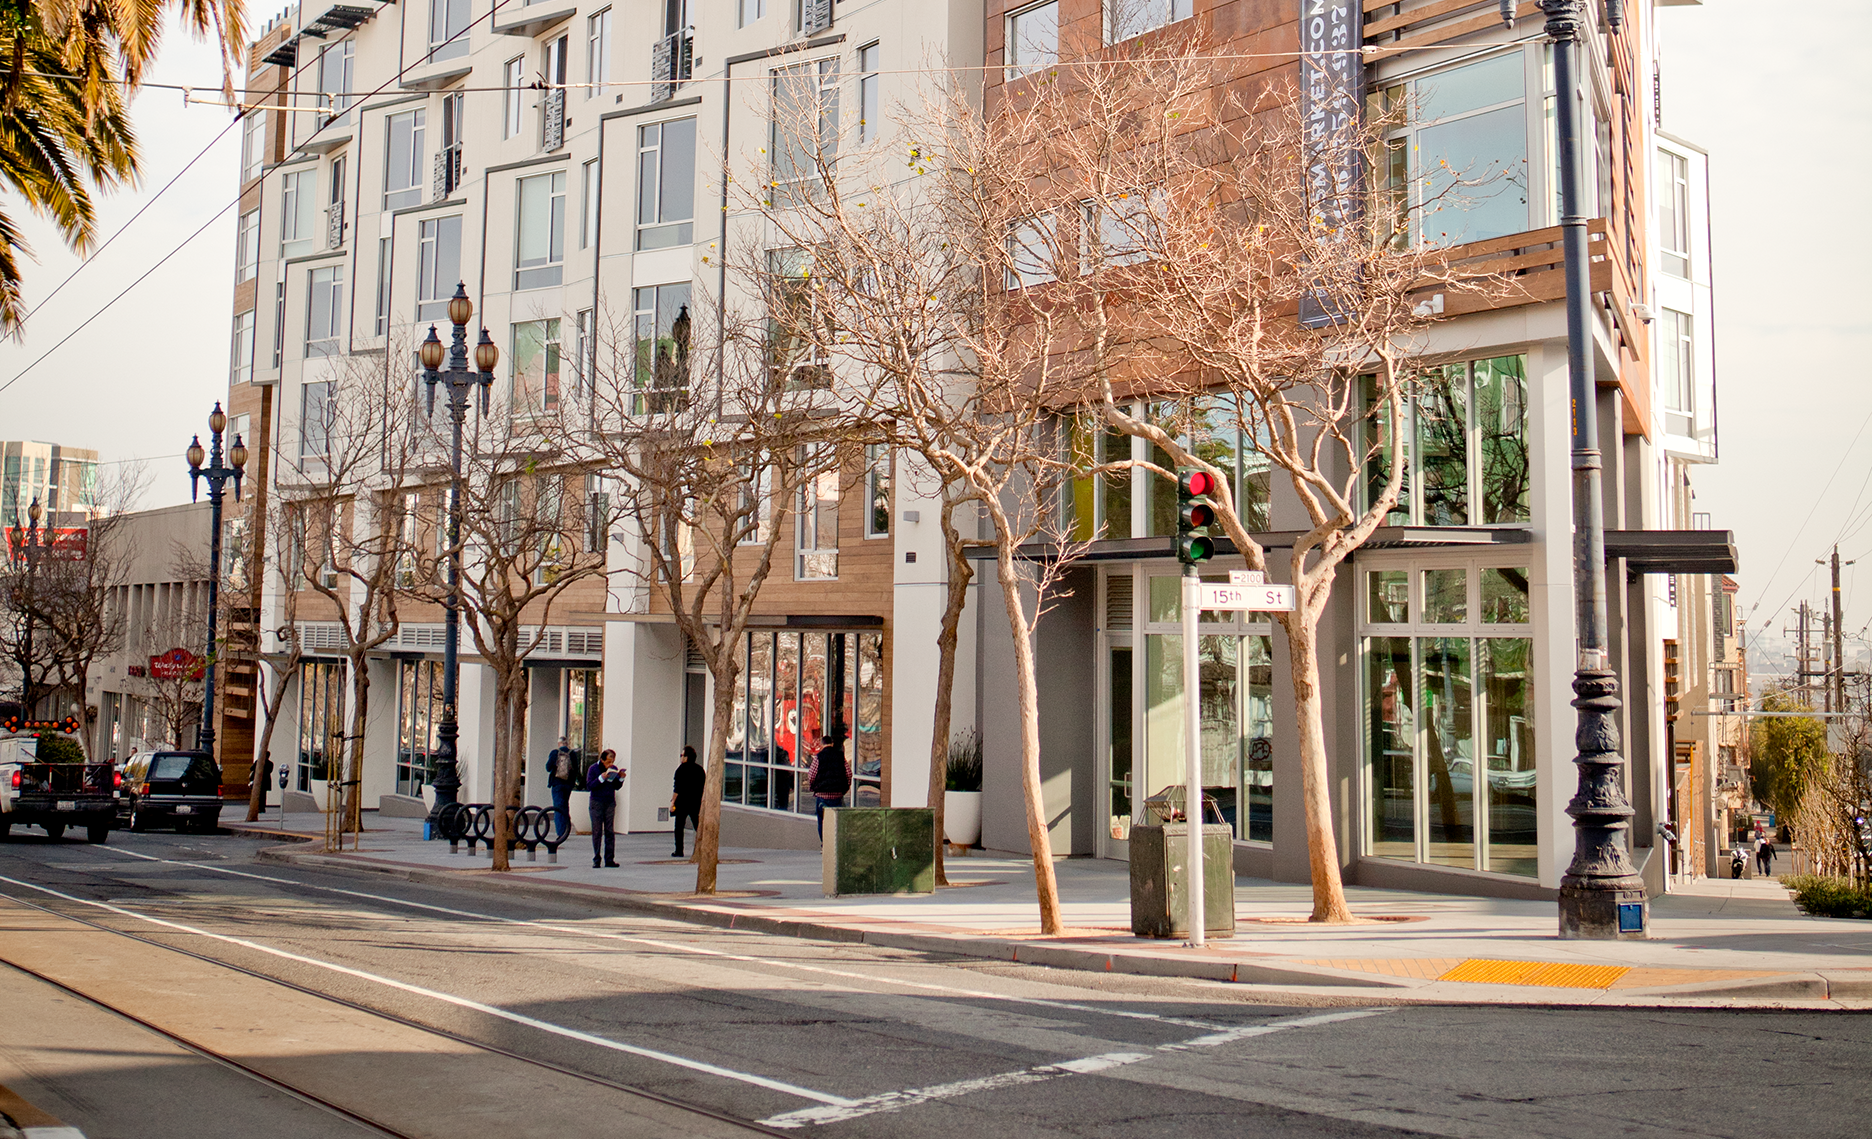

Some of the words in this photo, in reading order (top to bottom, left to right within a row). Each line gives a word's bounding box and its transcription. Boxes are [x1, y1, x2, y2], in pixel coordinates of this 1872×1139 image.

[1240, 574, 1261, 583] 2100
[1213, 590, 1242, 604] 15th
[1265, 590, 1282, 604] St
